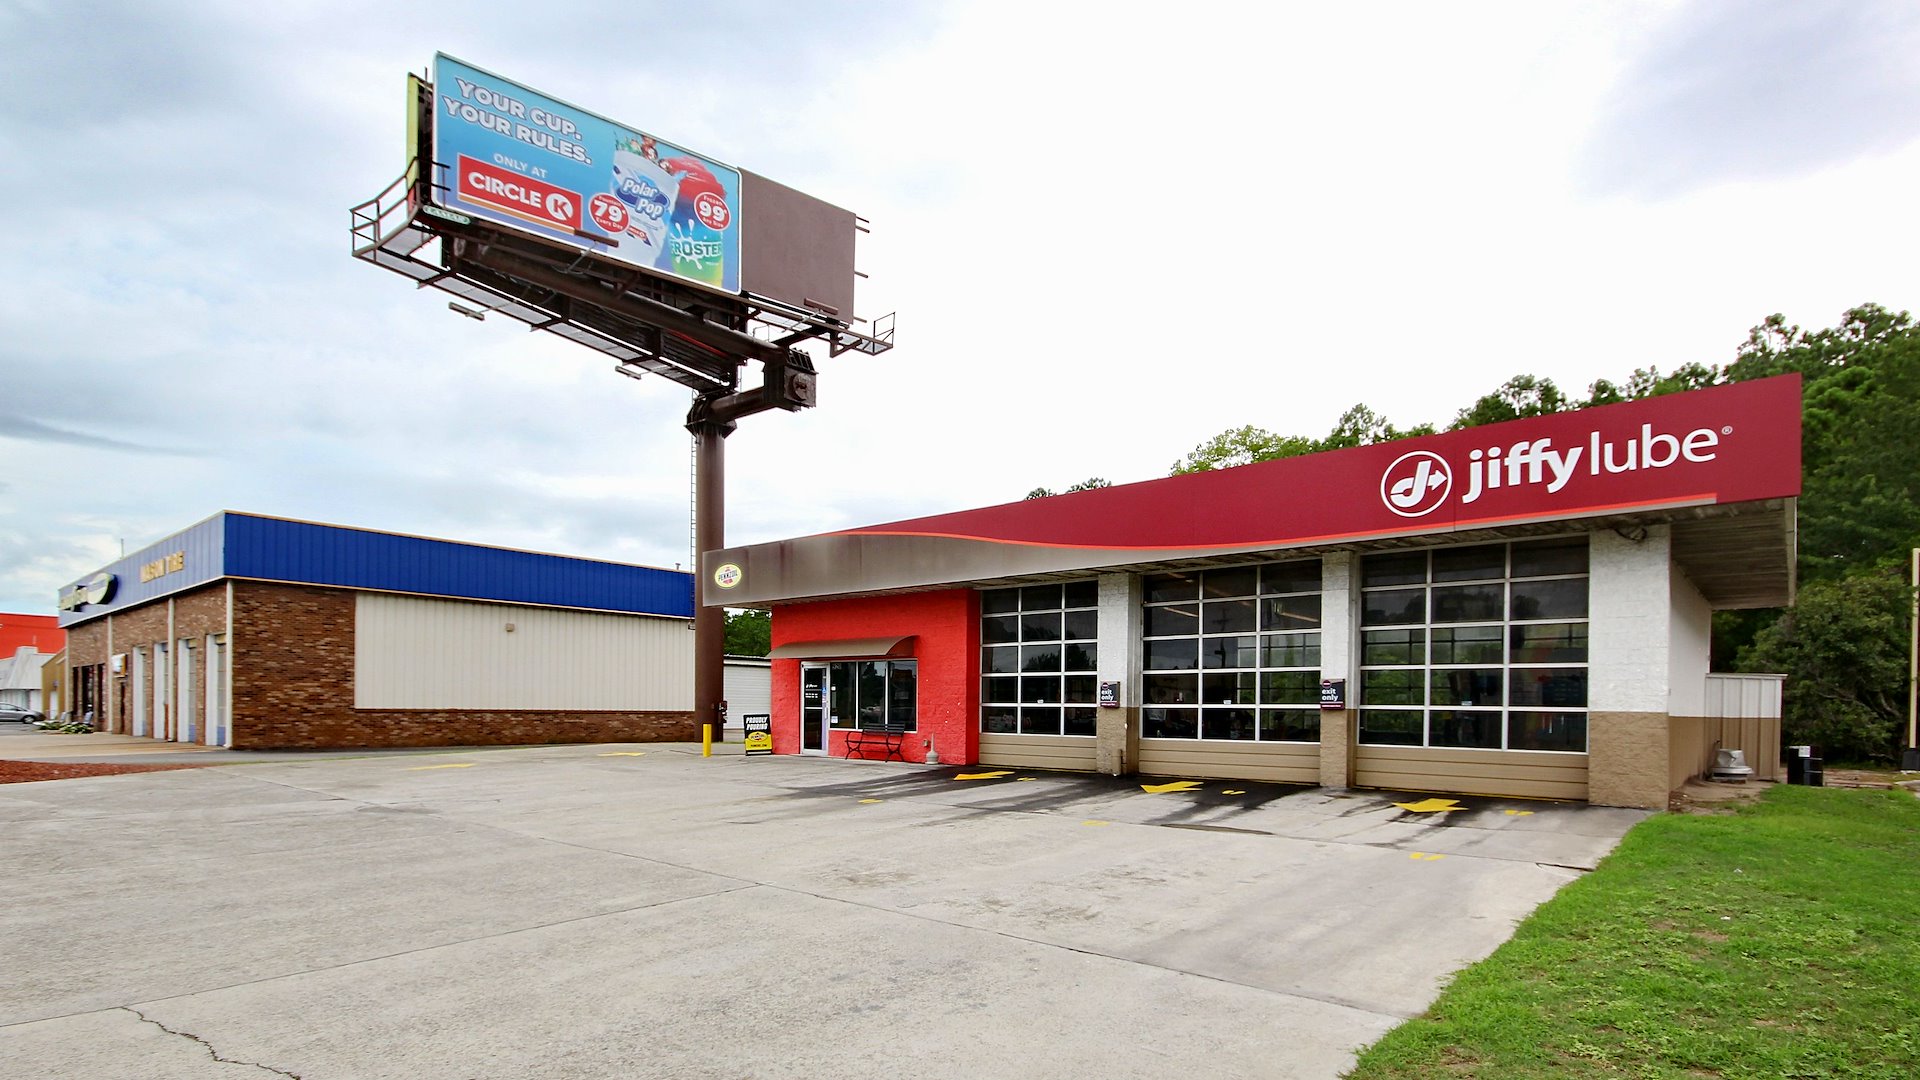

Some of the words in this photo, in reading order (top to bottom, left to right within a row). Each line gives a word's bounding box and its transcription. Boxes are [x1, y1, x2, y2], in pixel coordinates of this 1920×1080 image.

[455, 77, 527, 121] YOUR
[529, 107, 583, 141] CUP.
[441, 95, 513, 137] YOUR
[515, 123, 592, 165] RULES.
[493, 153, 528, 172] ONLY
[531, 165, 548, 179] AT
[468, 171, 542, 209] CIRCLE
[549, 196, 573, 221] K
[623, 178, 657, 198] Polar
[637, 199, 663, 219] Pop
[1462, 438, 1584, 503] jiffy
[1321, 694, 1338, 702] only
